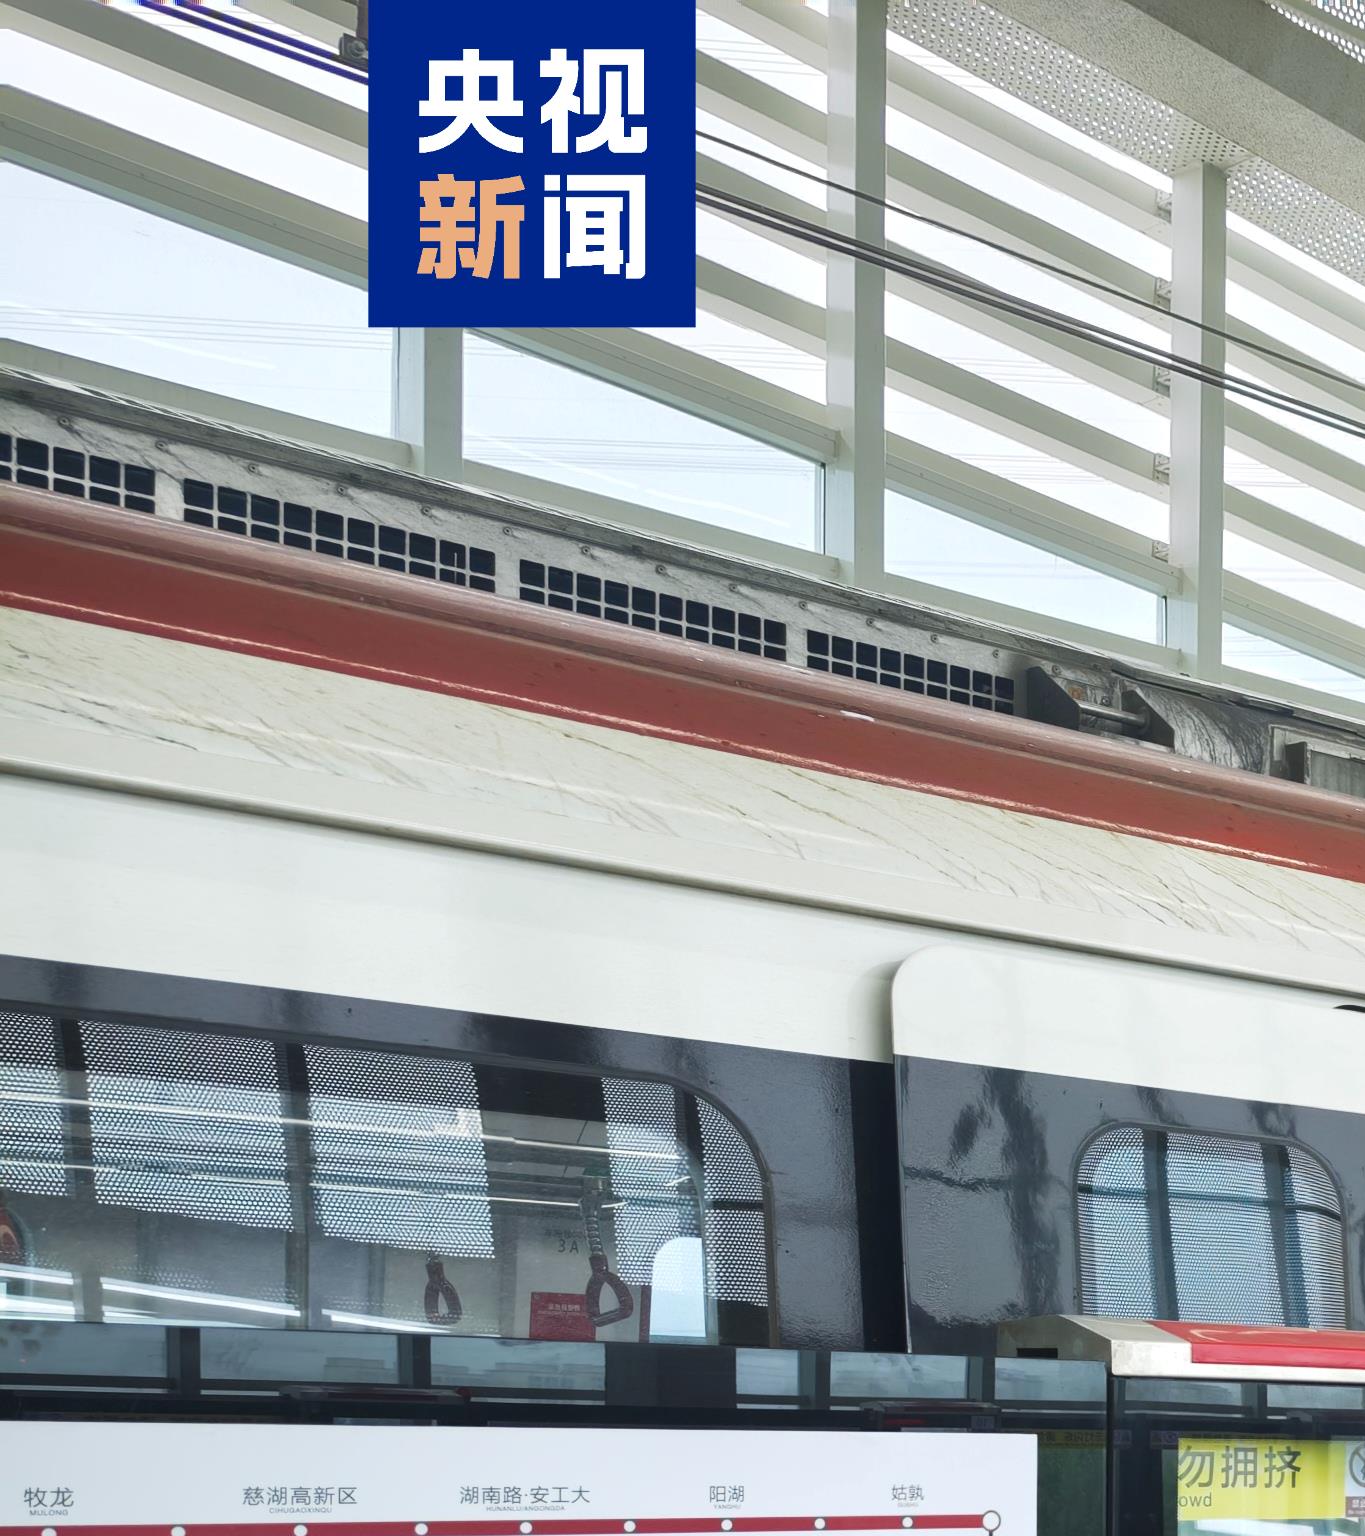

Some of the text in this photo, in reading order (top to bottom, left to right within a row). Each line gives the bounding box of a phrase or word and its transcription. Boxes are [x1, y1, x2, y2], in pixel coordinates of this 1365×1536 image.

[1178, 1445, 1301, 1489] 勿拥挤
[24, 1487, 74, 1508] 牧龙
[242, 1486, 357, 1506] 慈湖高新区
[460, 1486, 590, 1505] 湖南路·安工大
[709, 1485, 744, 1503] 阳湖
